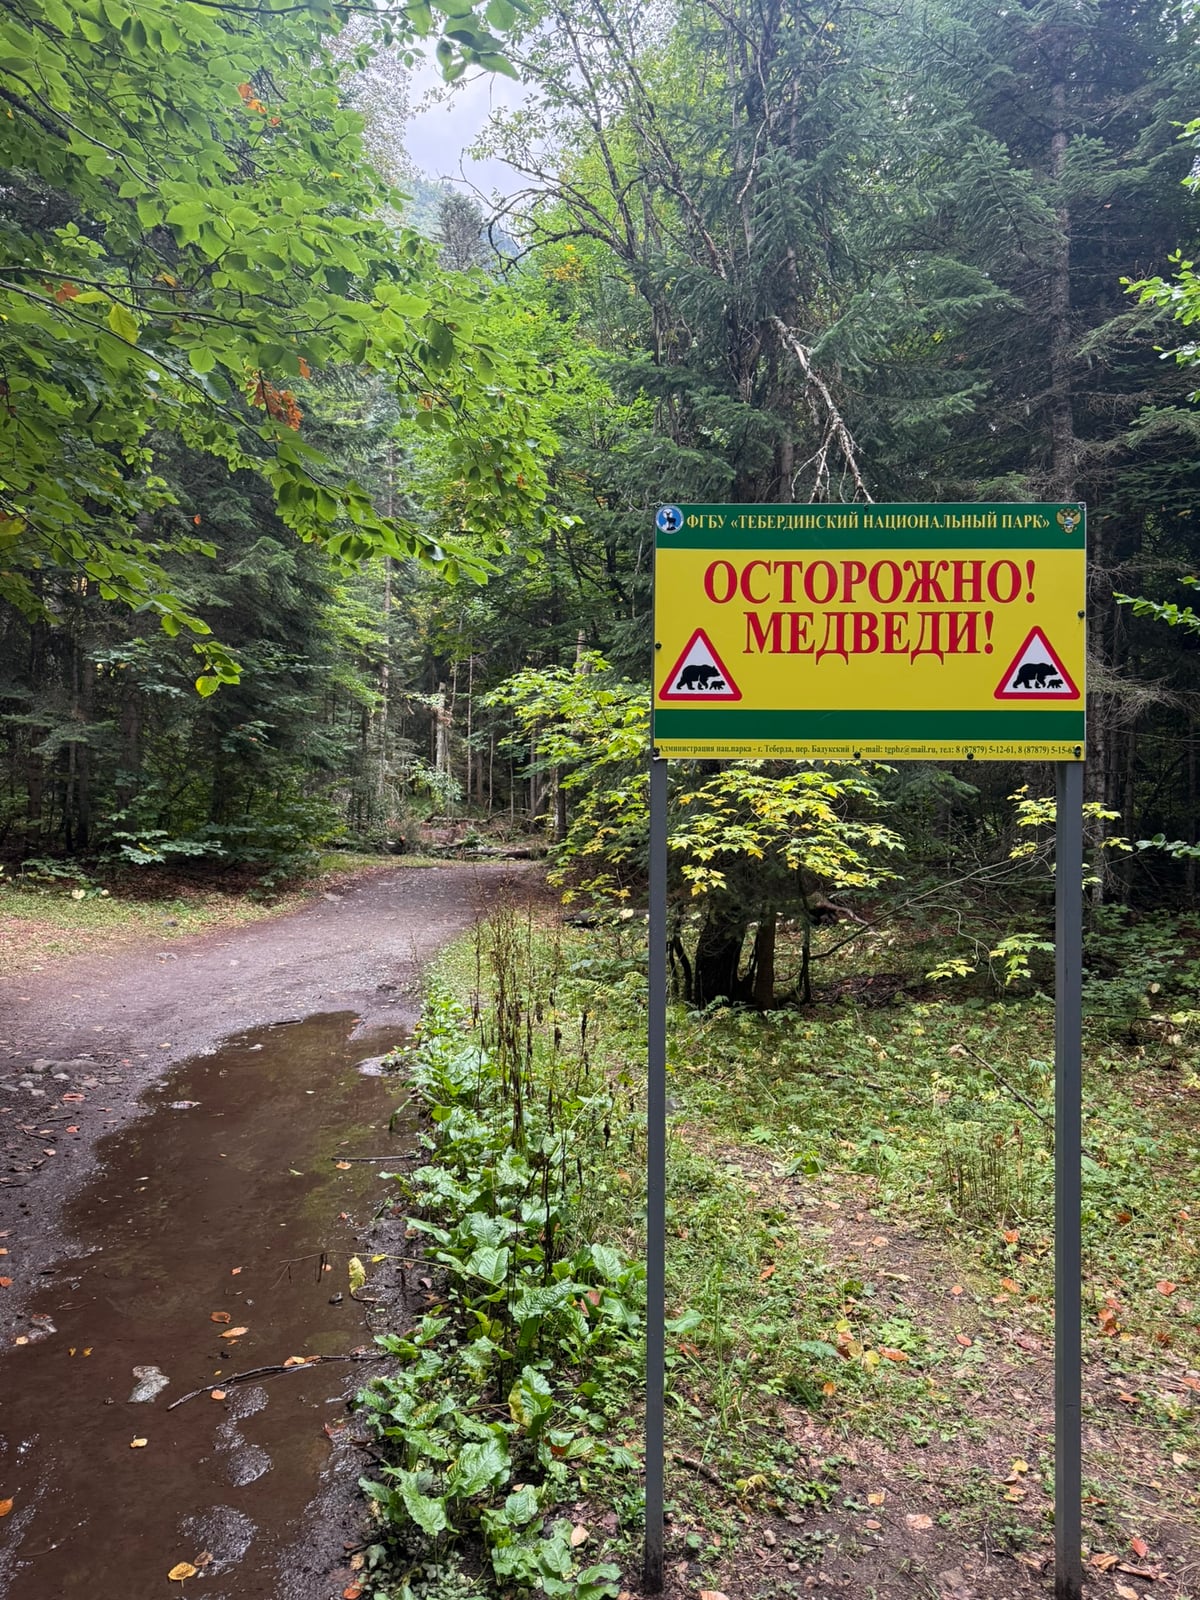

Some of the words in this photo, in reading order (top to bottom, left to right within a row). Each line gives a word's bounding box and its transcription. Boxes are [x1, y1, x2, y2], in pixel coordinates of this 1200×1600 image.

[686, 514, 727, 529] ФГБУ
[730, 511, 859, 531] «ТЕБЕРДИНСКИЙ
[863, 511, 997, 530] НАЦИОНАЛЬНЫЙ
[1001, 514, 1050, 529] ПАРК»
[704, 559, 1036, 604] ОСТОРОЖНО!
[743, 610, 995, 665] МЕДВЕДИ!
[660, 745, 714, 754] Администрация
[811, 745, 850, 754] Бадукский
[859, 745, 883, 753] e-mail:
[955, 745, 960, 753] 8
[962, 745, 987, 754] (87879)
[1024, 745, 1049, 755] (87879)
